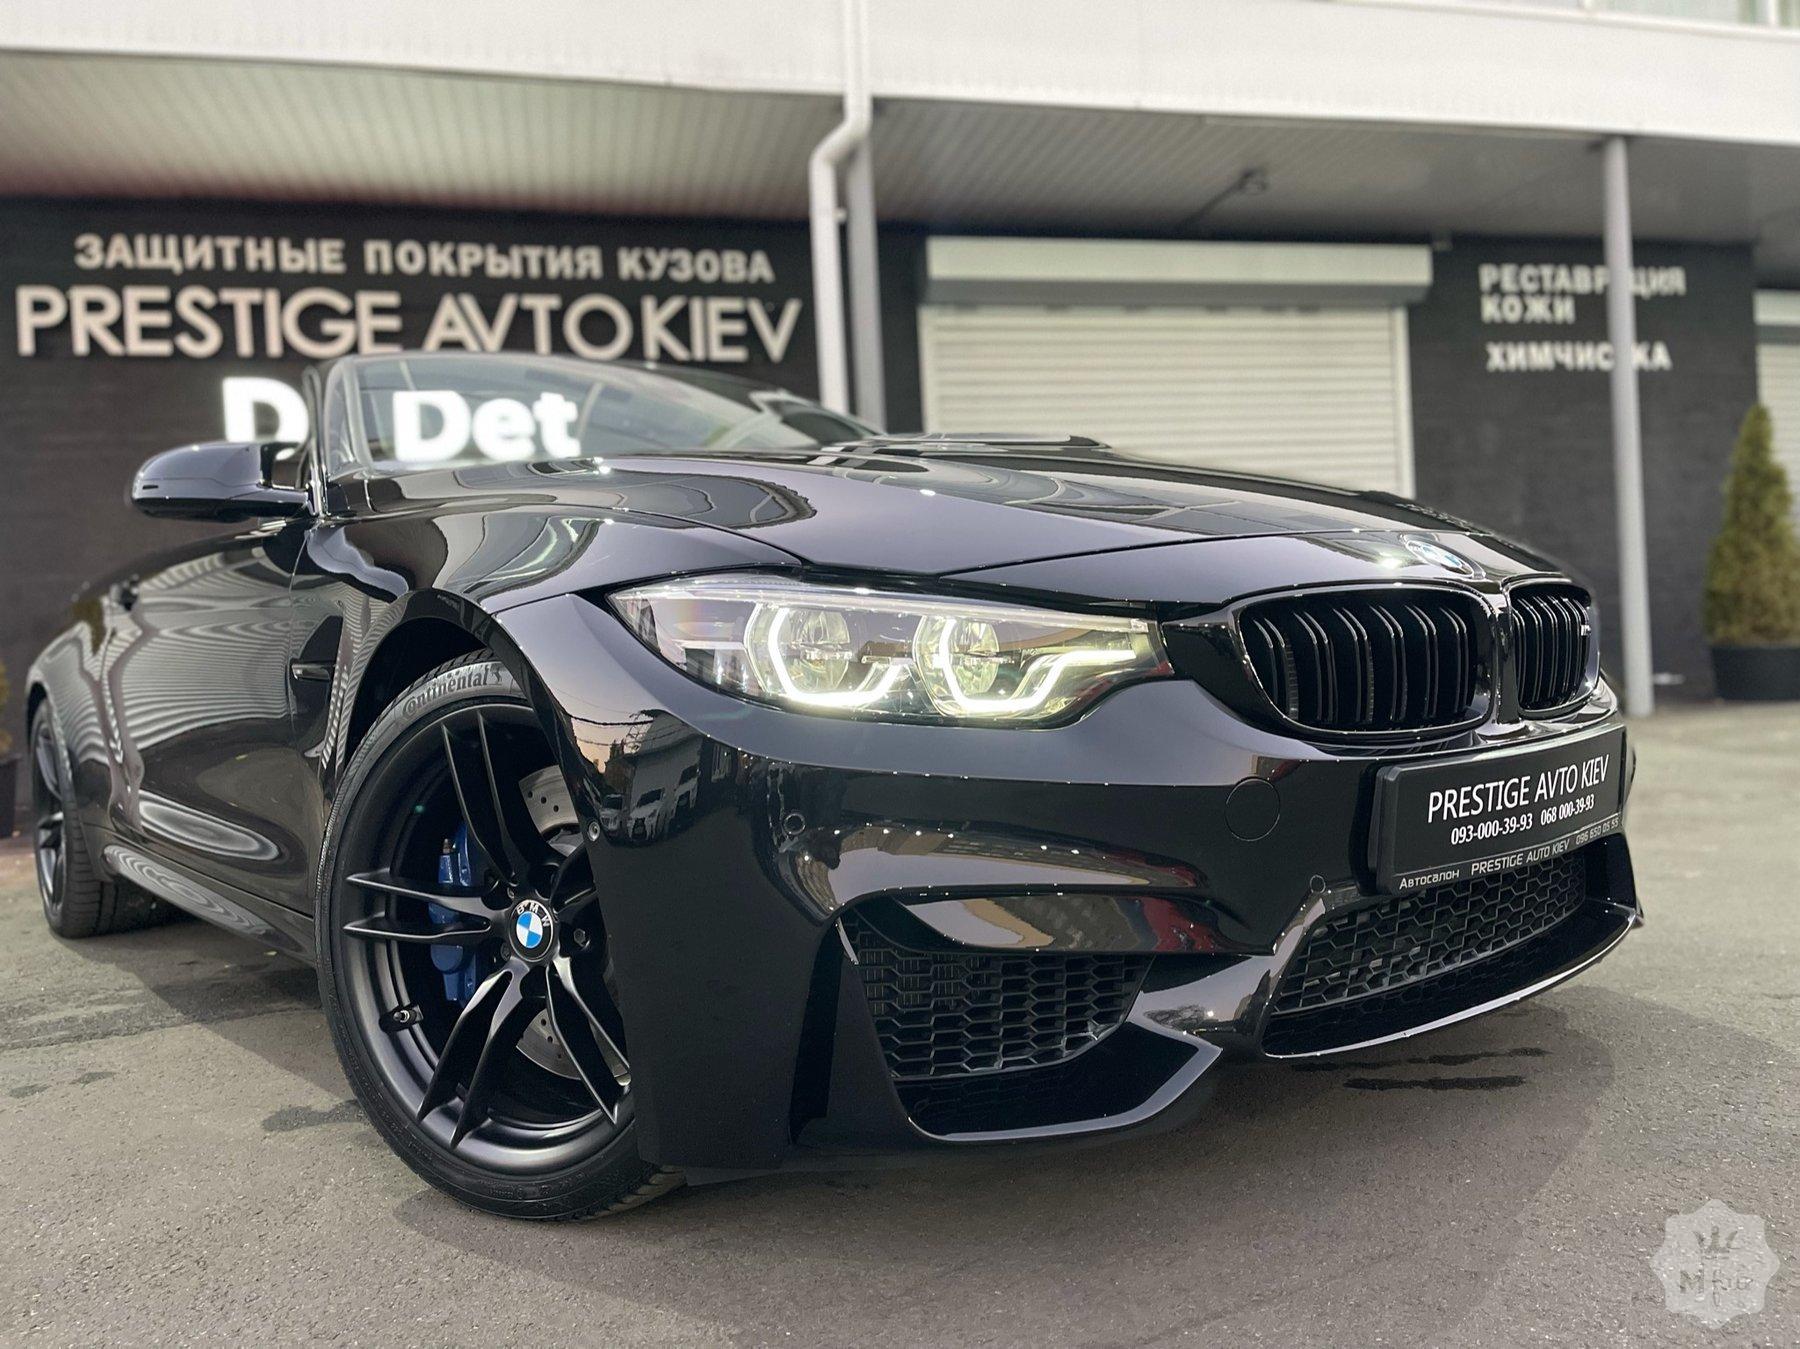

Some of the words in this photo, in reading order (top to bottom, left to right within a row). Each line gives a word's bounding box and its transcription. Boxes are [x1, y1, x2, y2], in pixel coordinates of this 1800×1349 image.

[74, 233, 346, 275] ЗАЩИТНЫЕ
[364, 239, 603, 280] ПОКРЫТИЯ
[617, 247, 775, 283] КУЗОВА
[1478, 263, 1687, 299] РЕСТАВРЦИЯ
[16, 284, 402, 358] PRESTIGE
[1480, 294, 1576, 324] КОЖИ
[1486, 341, 1673, 372] ХИМЧИСКА
[393, 390, 581, 462] Det
[402, 663, 489, 718] Continental
[1428, 775, 1530, 824] PRESTIGE
[1534, 764, 1578, 803] AVTO
[1581, 754, 1609, 789] KIEV
[1450, 812, 1533, 845] 093-000-39-93
[1540, 806, 1557, 826] 068
[1559, 793, 1594, 820] 000-39-93
[1399, 869, 1460, 891] Автосалон
[1471, 853, 1524, 876] PRESTIGE
[1526, 844, 1550, 864] AUTO
[1552, 839, 1570, 858] KIEV
[516, 901, 552, 928] BMW
